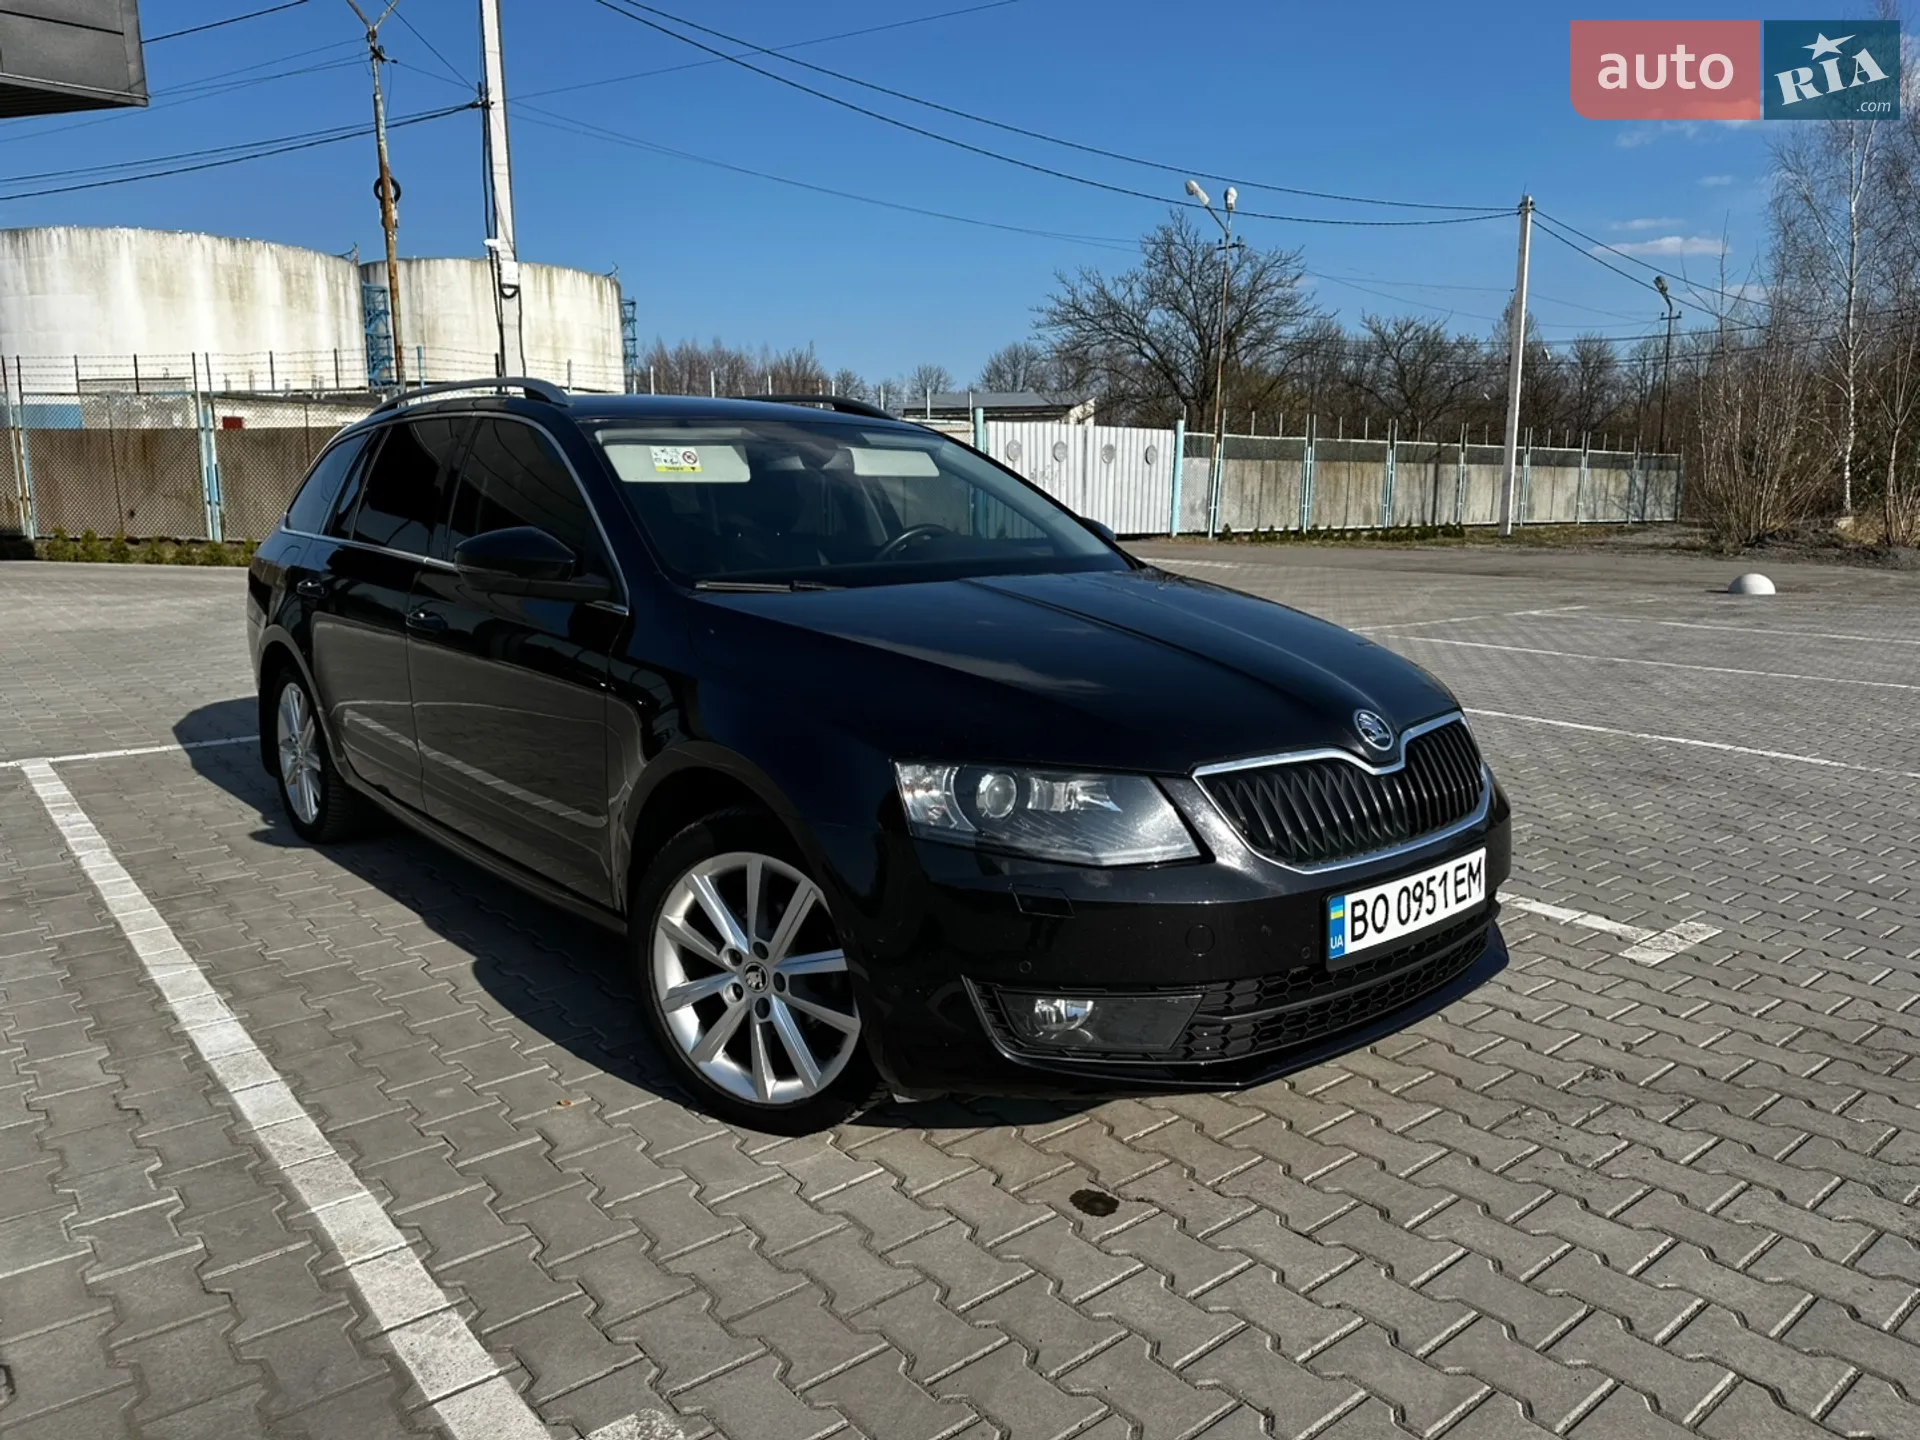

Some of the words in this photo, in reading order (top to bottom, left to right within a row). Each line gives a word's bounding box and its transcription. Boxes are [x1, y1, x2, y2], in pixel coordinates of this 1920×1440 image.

[1350, 893, 1389, 943] BO
[1397, 871, 1448, 926] 0951
[1454, 856, 1482, 905] EM
[1330, 934, 1344, 949] UA
